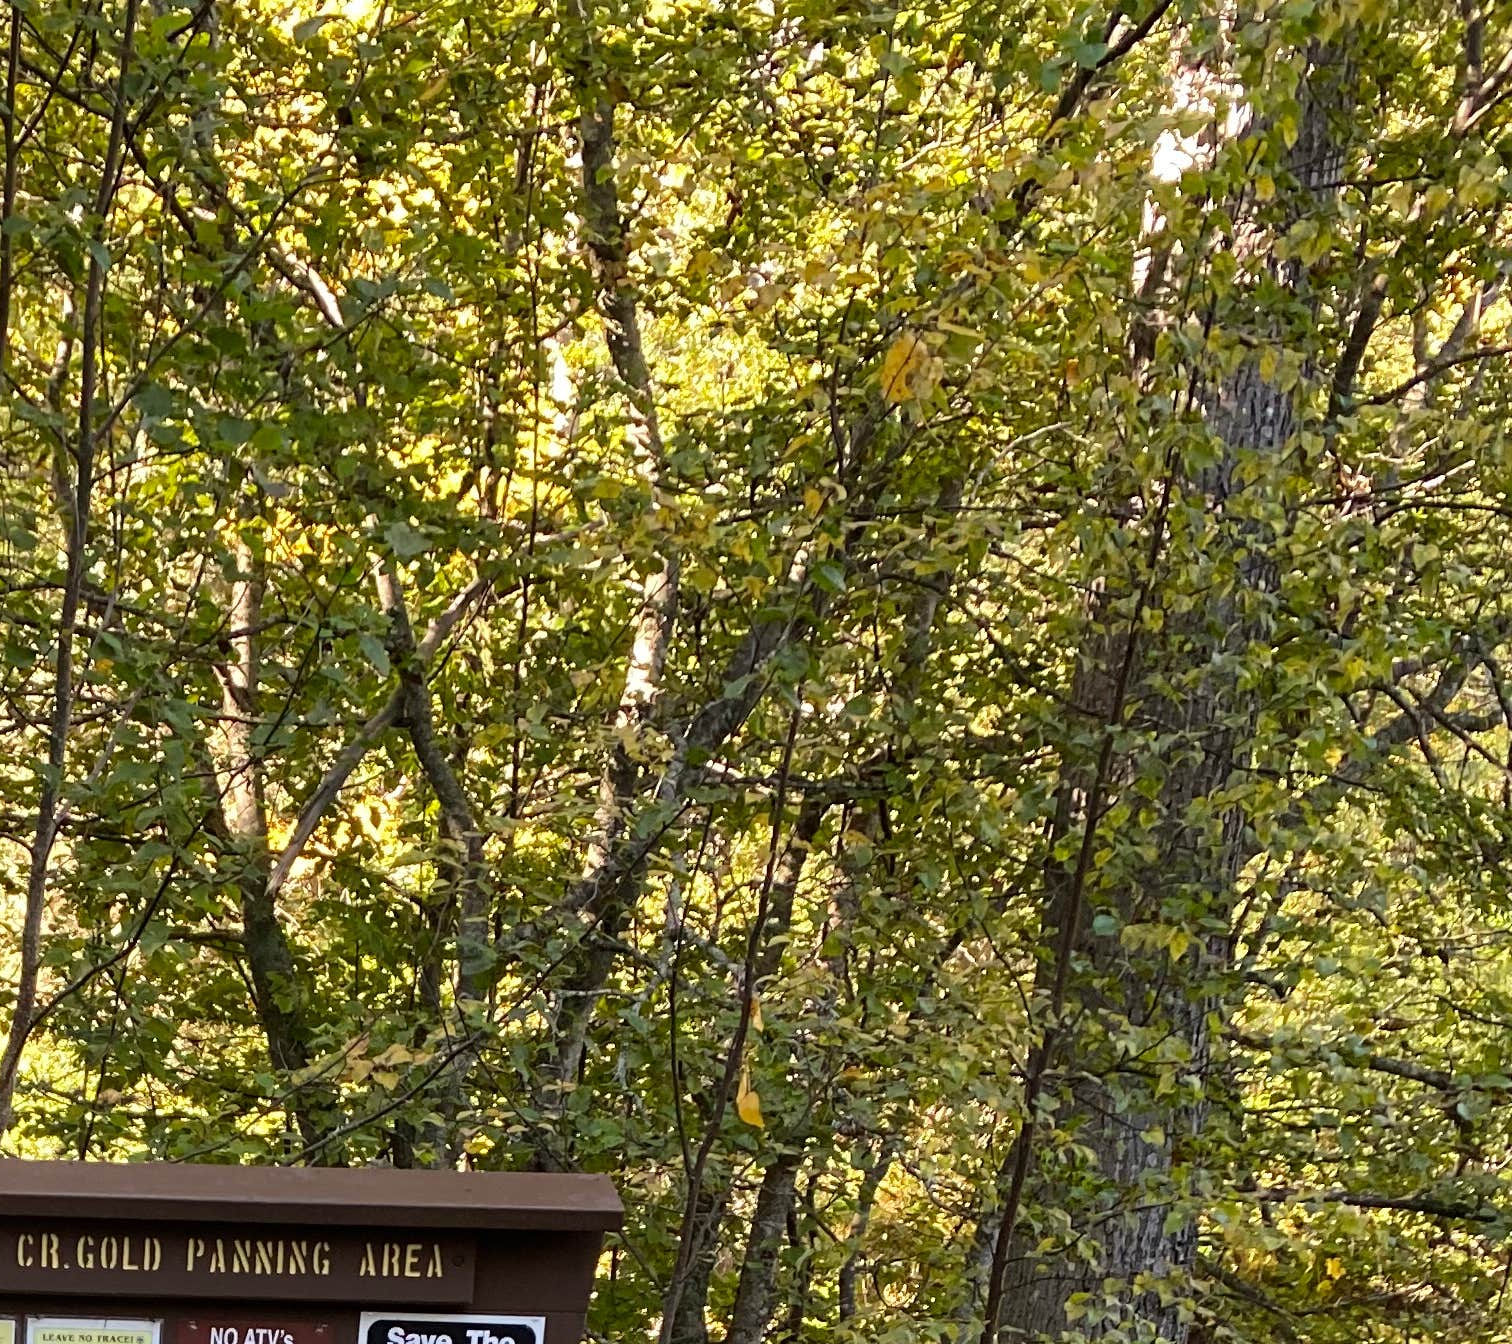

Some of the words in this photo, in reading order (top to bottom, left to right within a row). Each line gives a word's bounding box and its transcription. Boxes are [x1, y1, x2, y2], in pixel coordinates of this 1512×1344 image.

[186, 1237, 330, 1275] PANNING
[360, 1242, 443, 1278] AREA
[42, 1333, 75, 1342] LEAVE
[78, 1334, 93, 1343] NO
